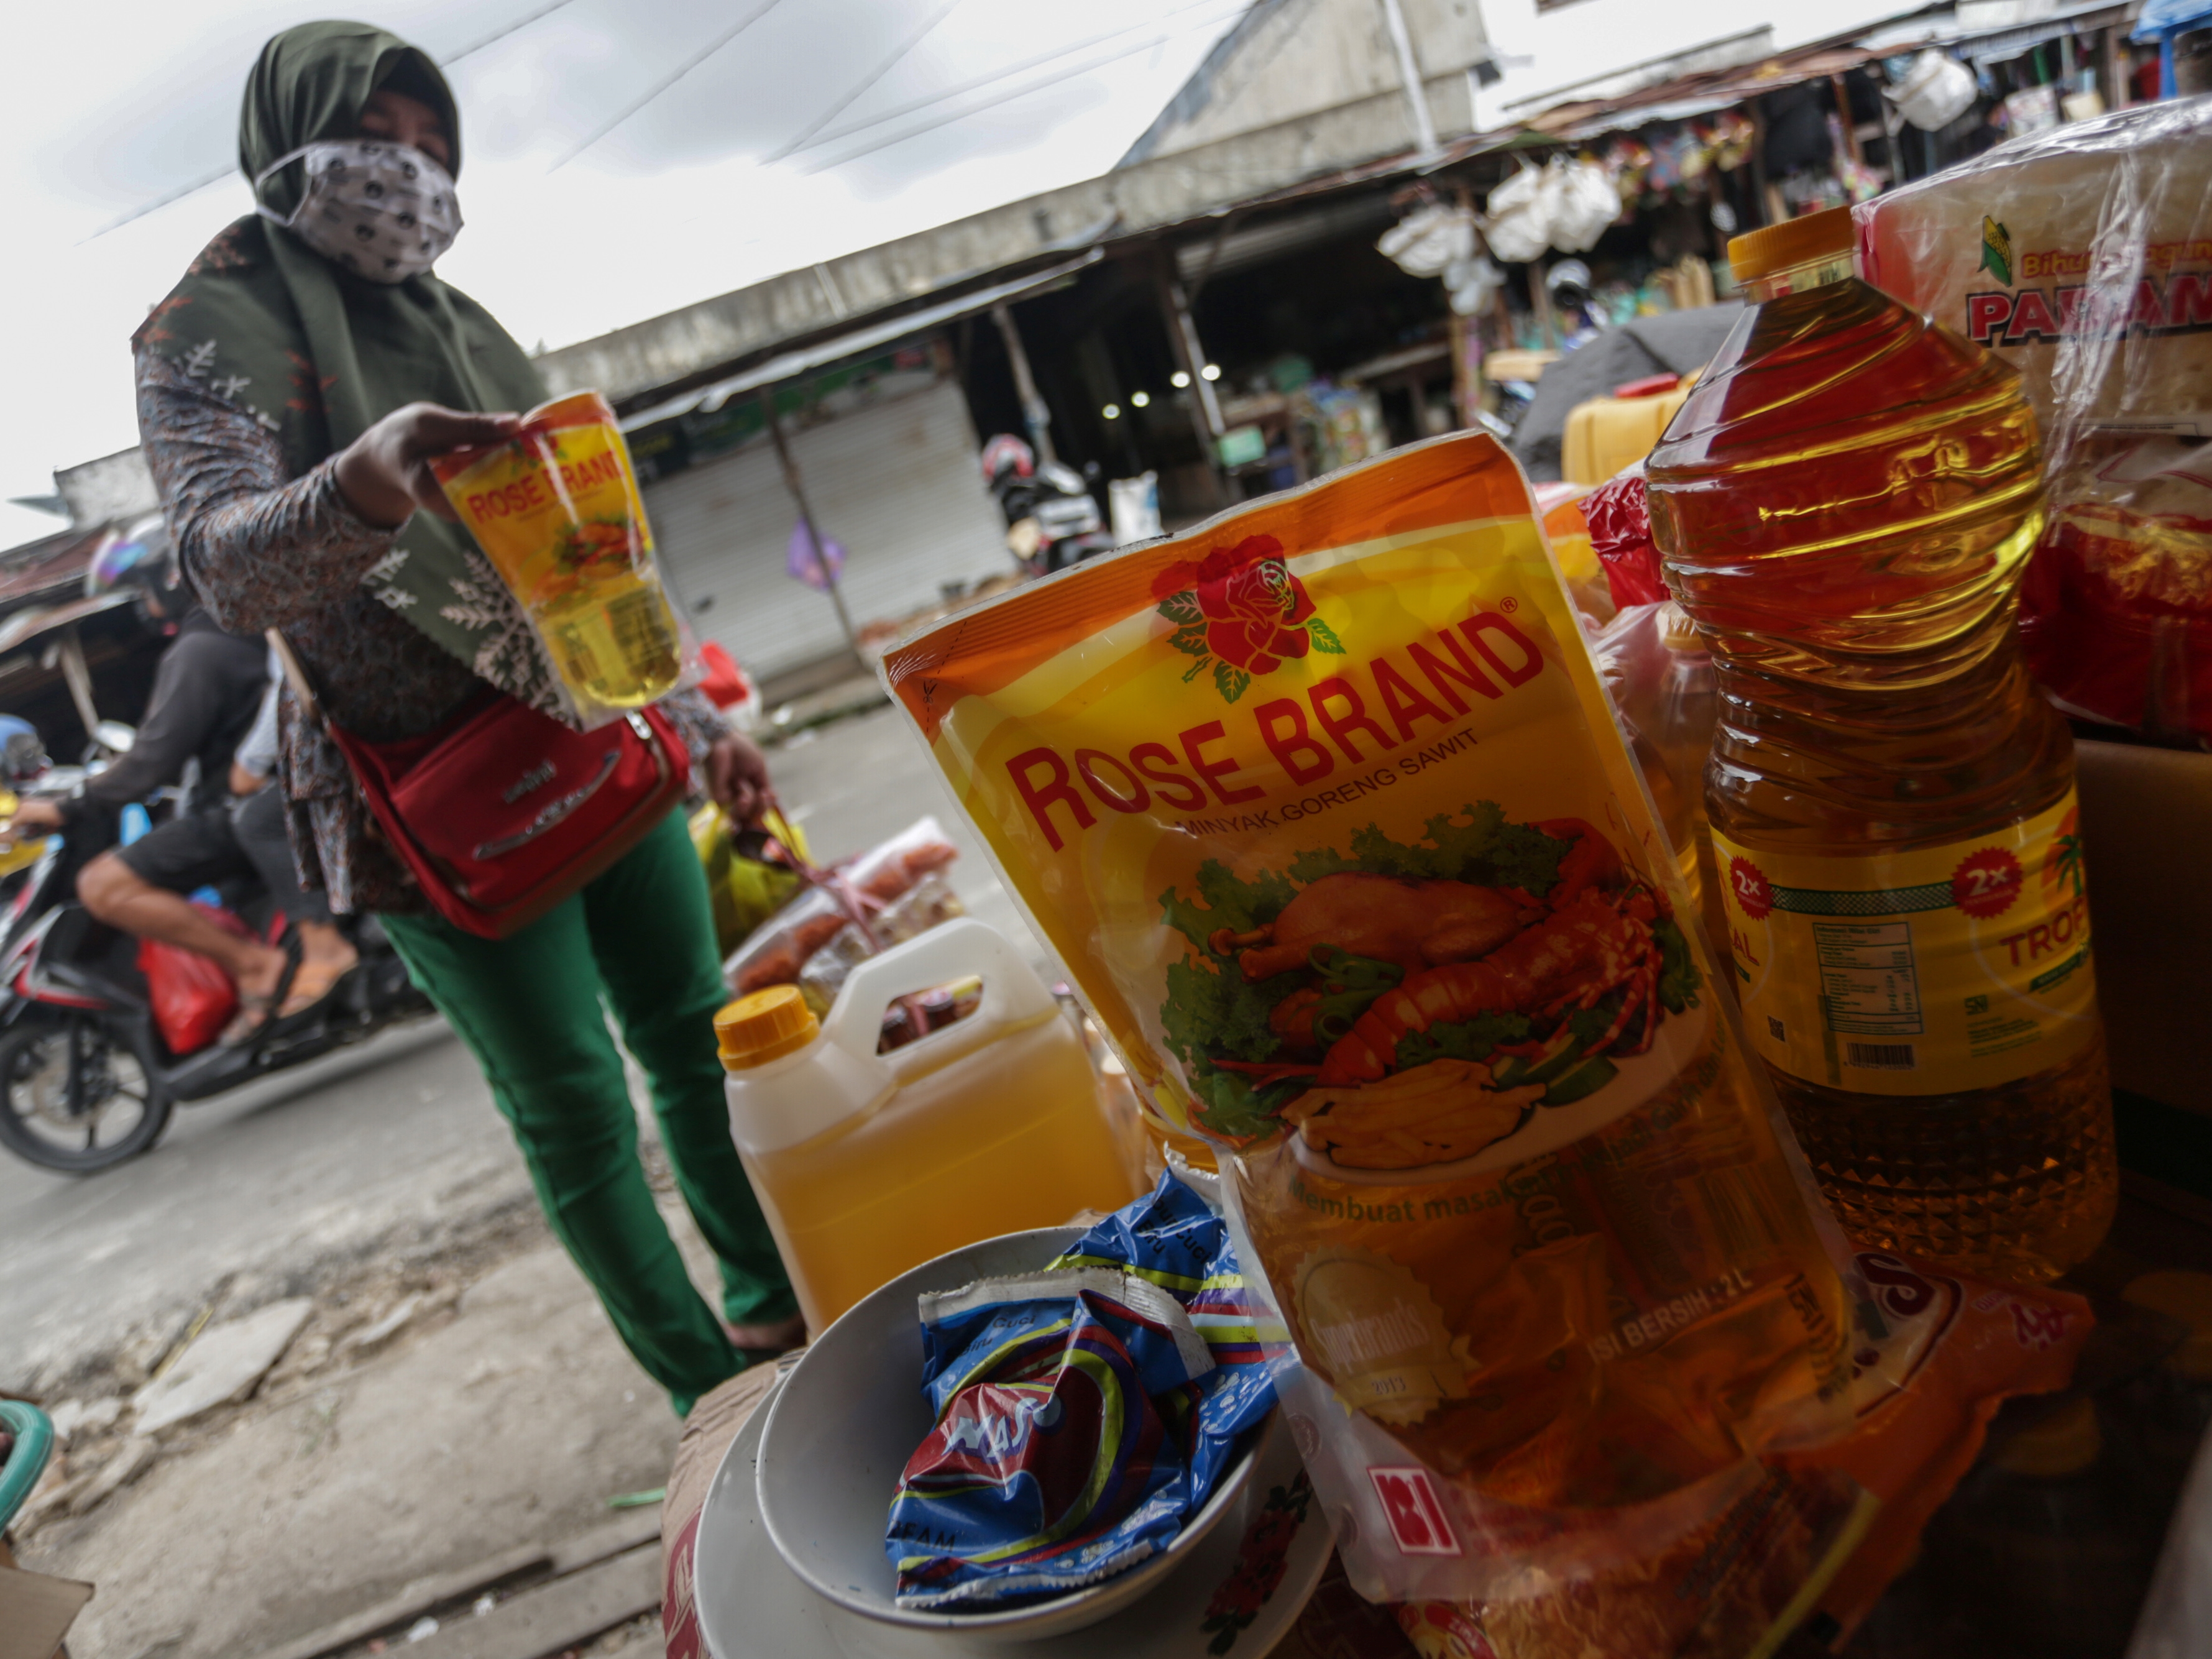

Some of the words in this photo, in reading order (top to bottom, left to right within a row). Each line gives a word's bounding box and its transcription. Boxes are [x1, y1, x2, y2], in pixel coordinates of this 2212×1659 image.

[468, 475, 544, 523] ROSE
[1005, 720, 1267, 853] ROSE
[1254, 610, 1545, 786] BRAND
[1173, 809, 1280, 837] MINYAK
[1283, 769, 1398, 822] GORENG
[1398, 728, 1482, 775] SAWIT
[1288, 1175, 1415, 1222] Membuat
[992, 1315, 1037, 1328] Cuci
[1587, 1331, 1623, 1364] ISI
[1620, 1287, 1711, 1348] BERSIH
